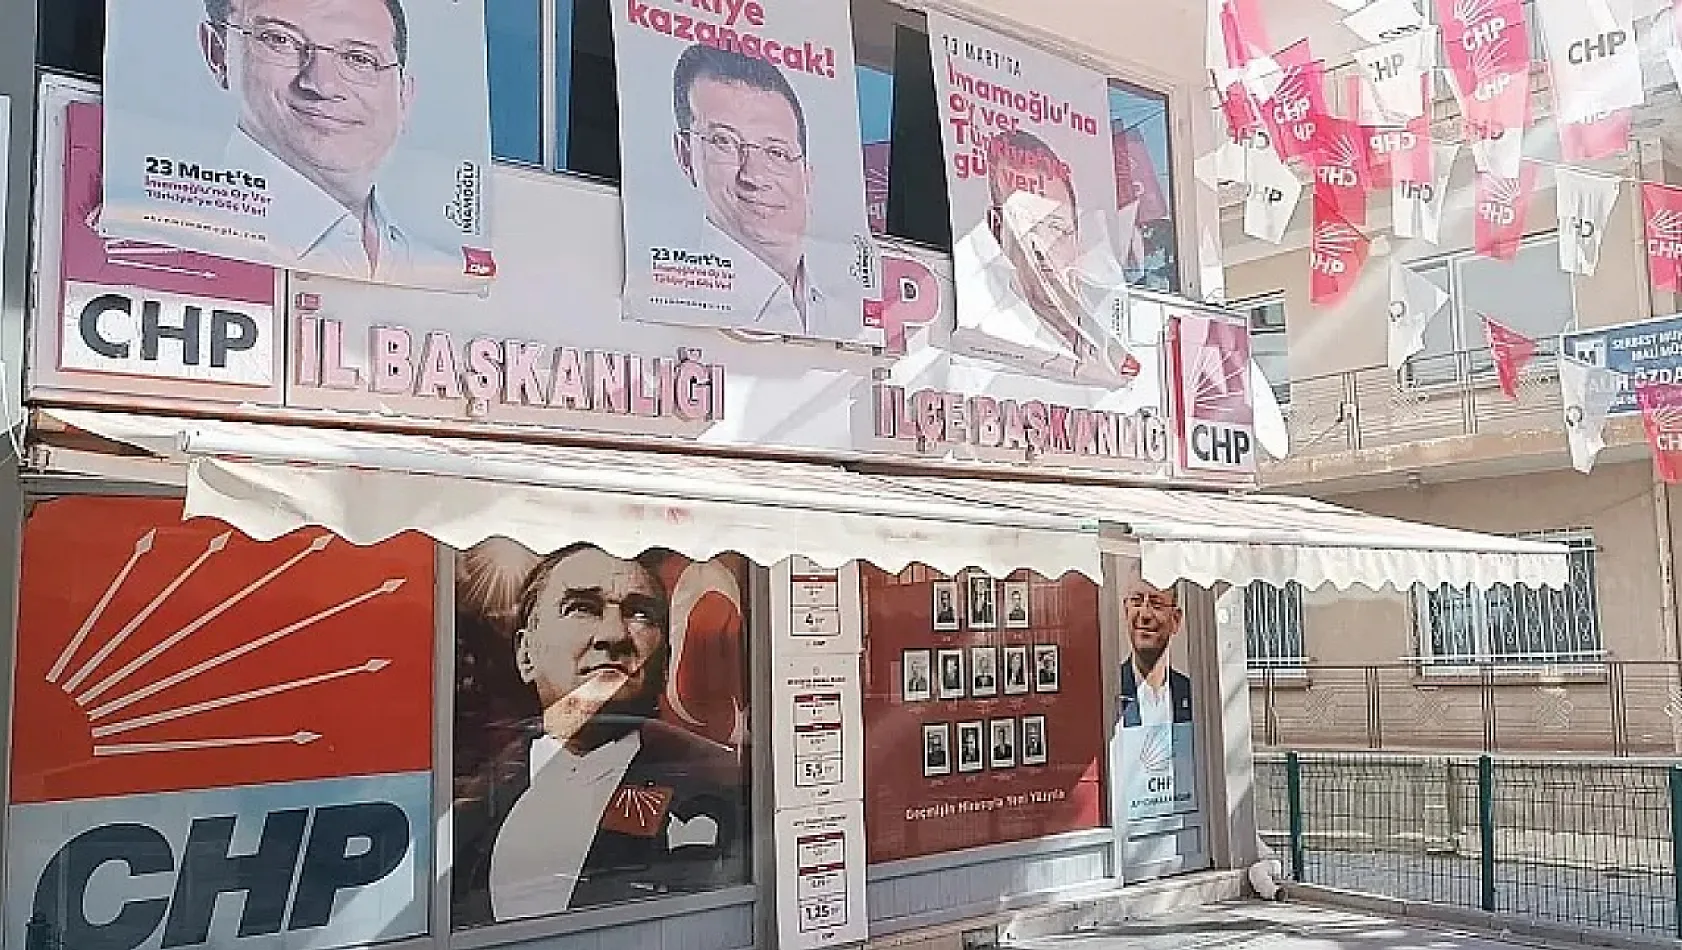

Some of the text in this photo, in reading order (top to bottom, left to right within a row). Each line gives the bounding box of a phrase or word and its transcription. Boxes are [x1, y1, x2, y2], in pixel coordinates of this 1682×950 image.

[627, 1, 835, 78] kazanacak!
[1463, 18, 1505, 50] CHP
[1568, 30, 1626, 64] CHP
[1368, 54, 1404, 82] HP
[947, 53, 1098, 135] İmamoğlu'na
[145, 156, 266, 190] 23 Mart'ta
[650, 247, 669, 261] 23
[79, 293, 259, 367] CHP
[295, 293, 725, 421] İL BAŞKANLIĞI
[871, 367, 967, 452] İLÇE
[1192, 424, 1249, 464] CHP
[1656, 431, 1682, 451] CH
[32, 801, 411, 950] CHP
